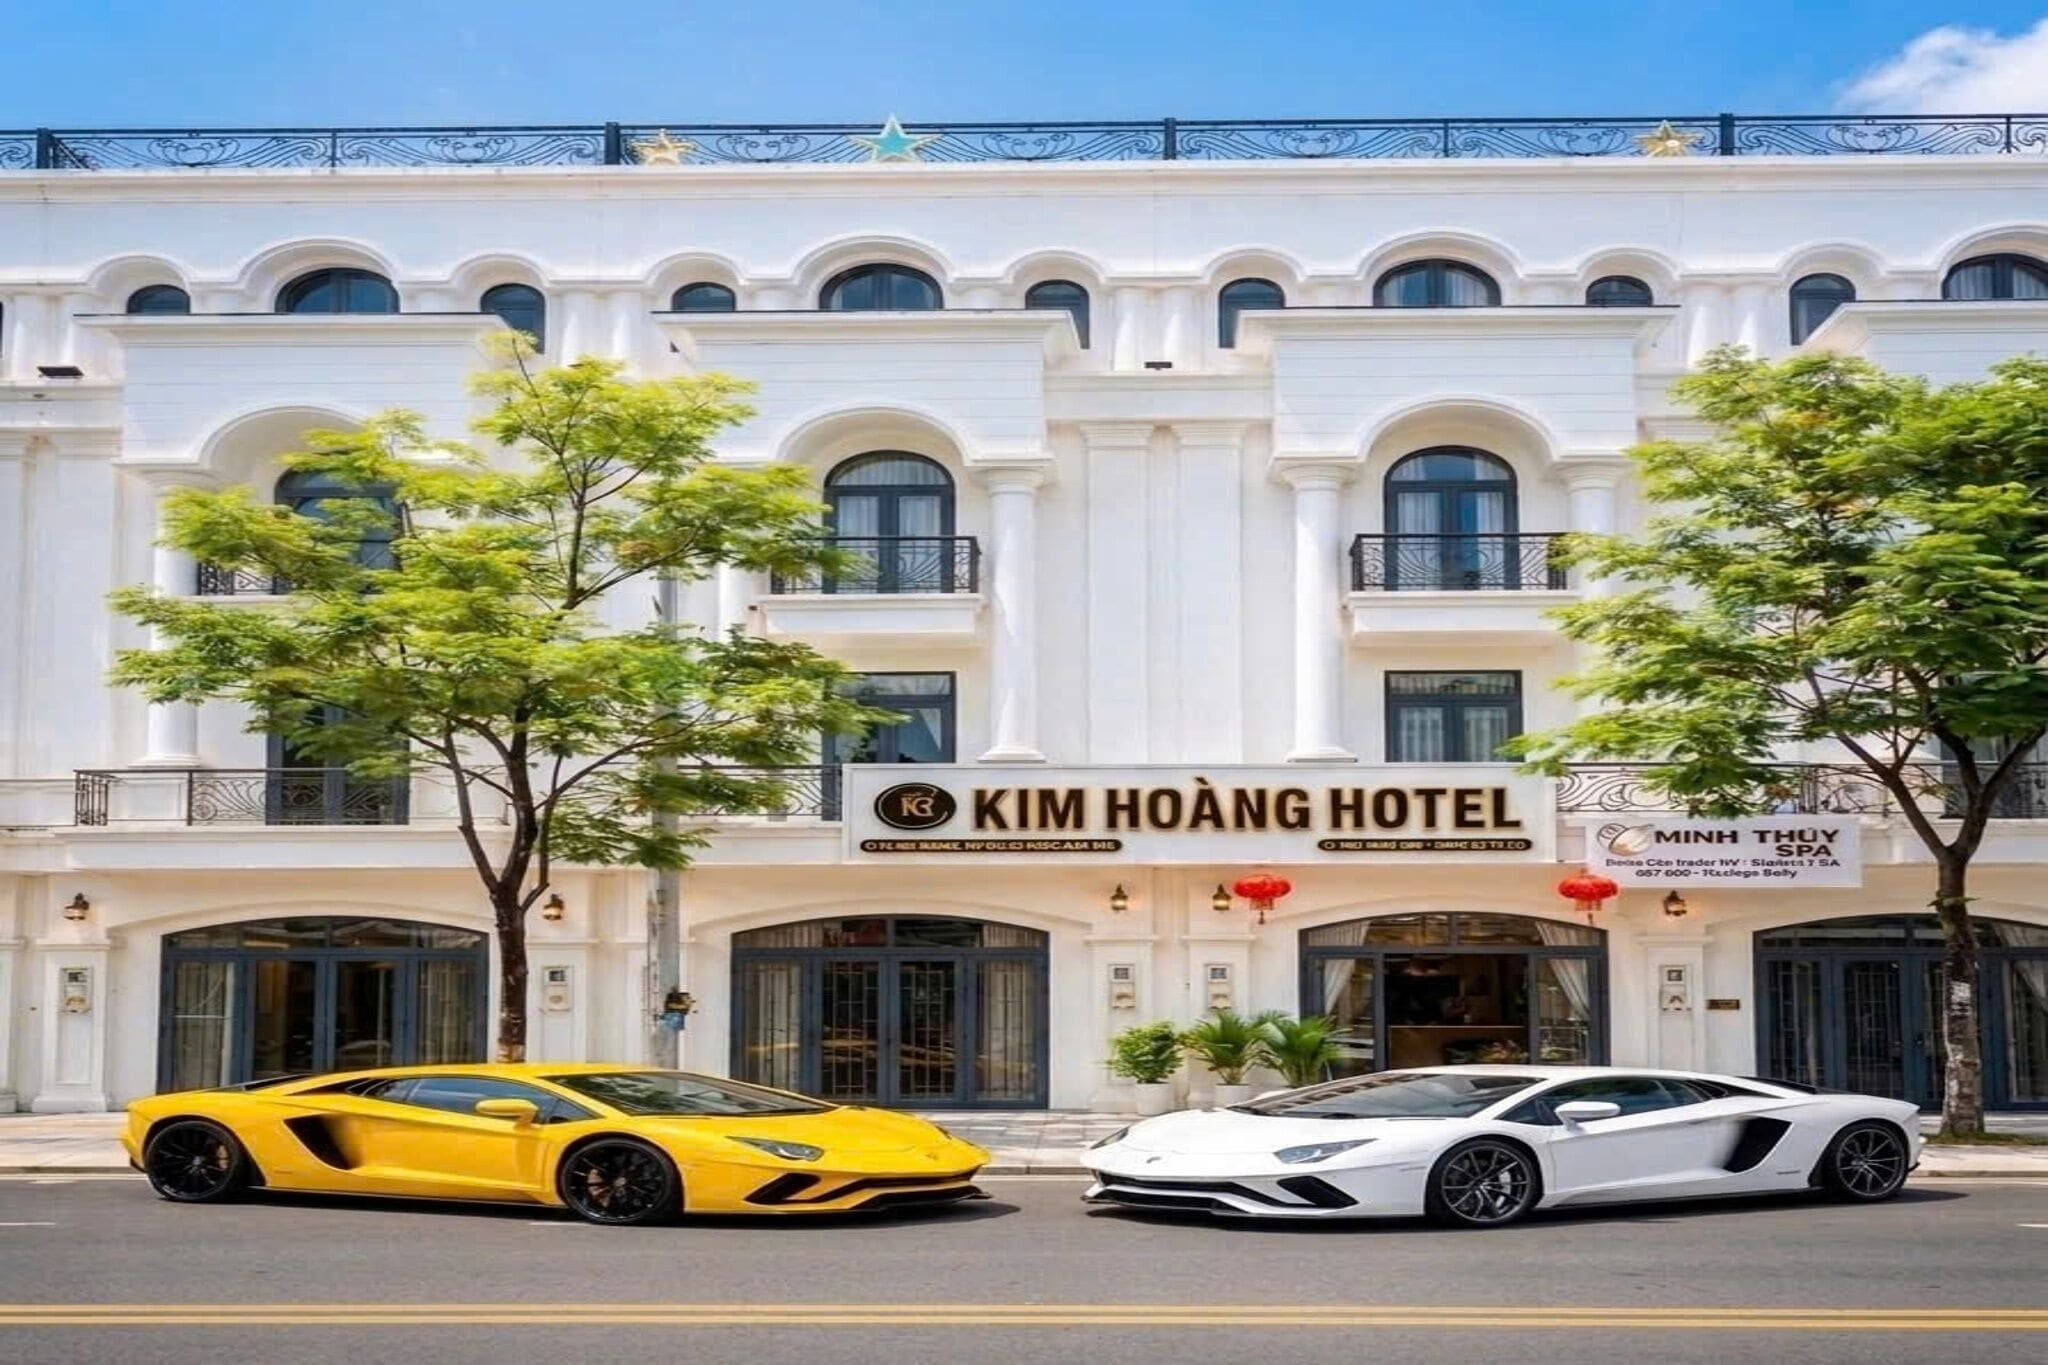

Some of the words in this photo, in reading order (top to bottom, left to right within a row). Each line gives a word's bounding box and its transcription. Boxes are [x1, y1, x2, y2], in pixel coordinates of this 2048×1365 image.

[974, 788, 1085, 830] KIM
[1105, 776, 1311, 830] HOÀNG
[1329, 787, 1522, 830] HOTEL
[1654, 830, 1739, 844] MINH
[1775, 844, 1832, 857] SPA
